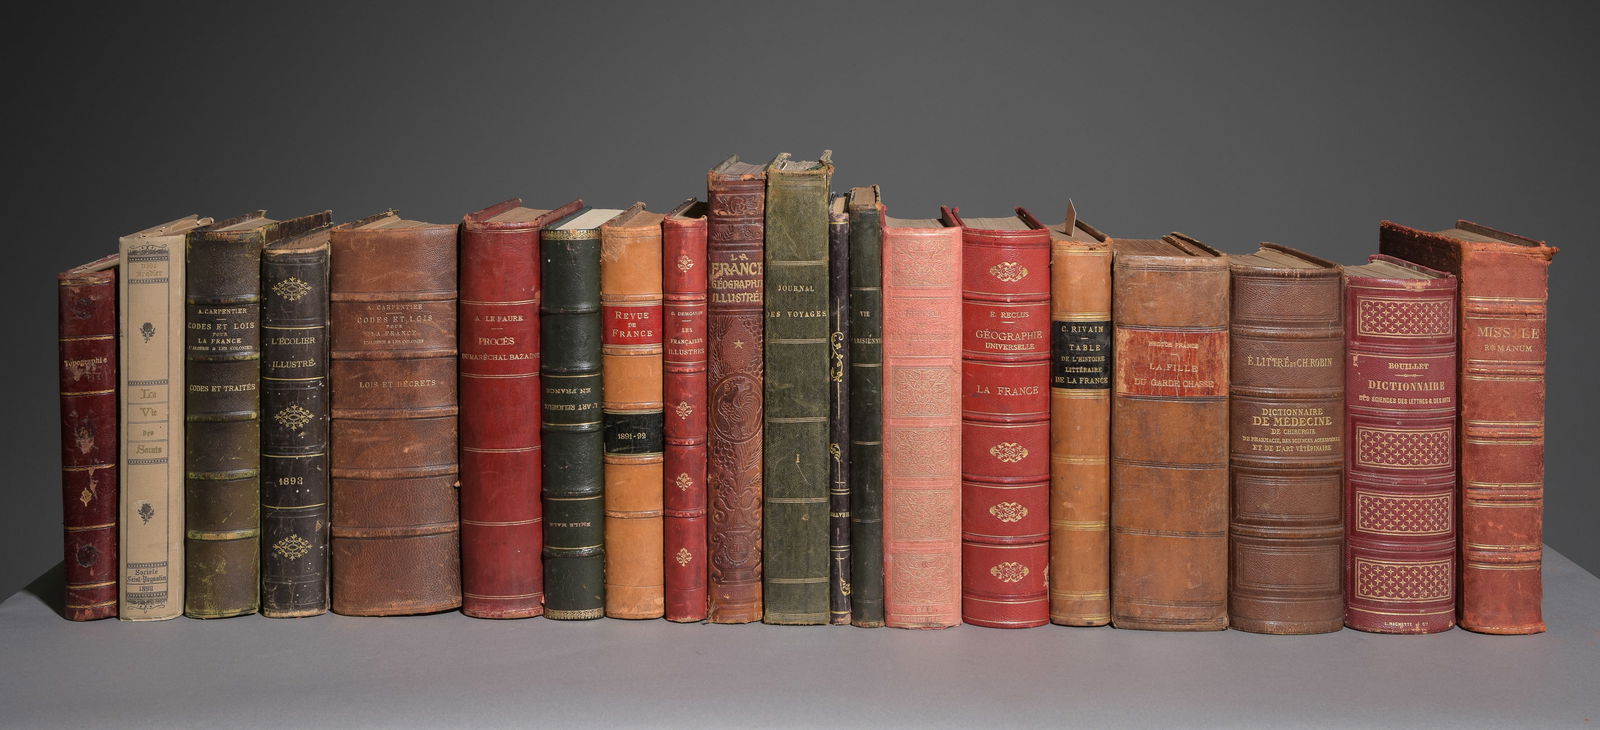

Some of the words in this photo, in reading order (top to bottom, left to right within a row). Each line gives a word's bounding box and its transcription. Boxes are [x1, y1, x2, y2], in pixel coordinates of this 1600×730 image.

[615, 311, 649, 320] REVUE
[612, 329, 653, 337] FRANCE
[976, 328, 1042, 340] GÉOGRAPHIE
[1477, 326, 1540, 339] MISSLE
[479, 336, 515, 345] PROCÈS
[985, 342, 1035, 350] UNIVERSELLE
[1484, 344, 1533, 352] ROMANUM
[272, 357, 316, 368] ILLUSTRÉ
[1166, 364, 1198, 373] FILLE
[1079, 376, 1108, 384] FRANCE
[1134, 377, 1147, 385] DU
[1151, 379, 1180, 387] GARDE
[223, 383, 256, 392] TRAITÉS
[1368, 380, 1445, 391] DICTIONNAIRE
[976, 385, 990, 394] LA
[997, 385, 1039, 396] FRANCE
[140, 407, 157, 416] Vie
[1252, 416, 1270, 426] DE
[1273, 416, 1332, 427] MÉDECINE
[279, 476, 303, 486] 1893
